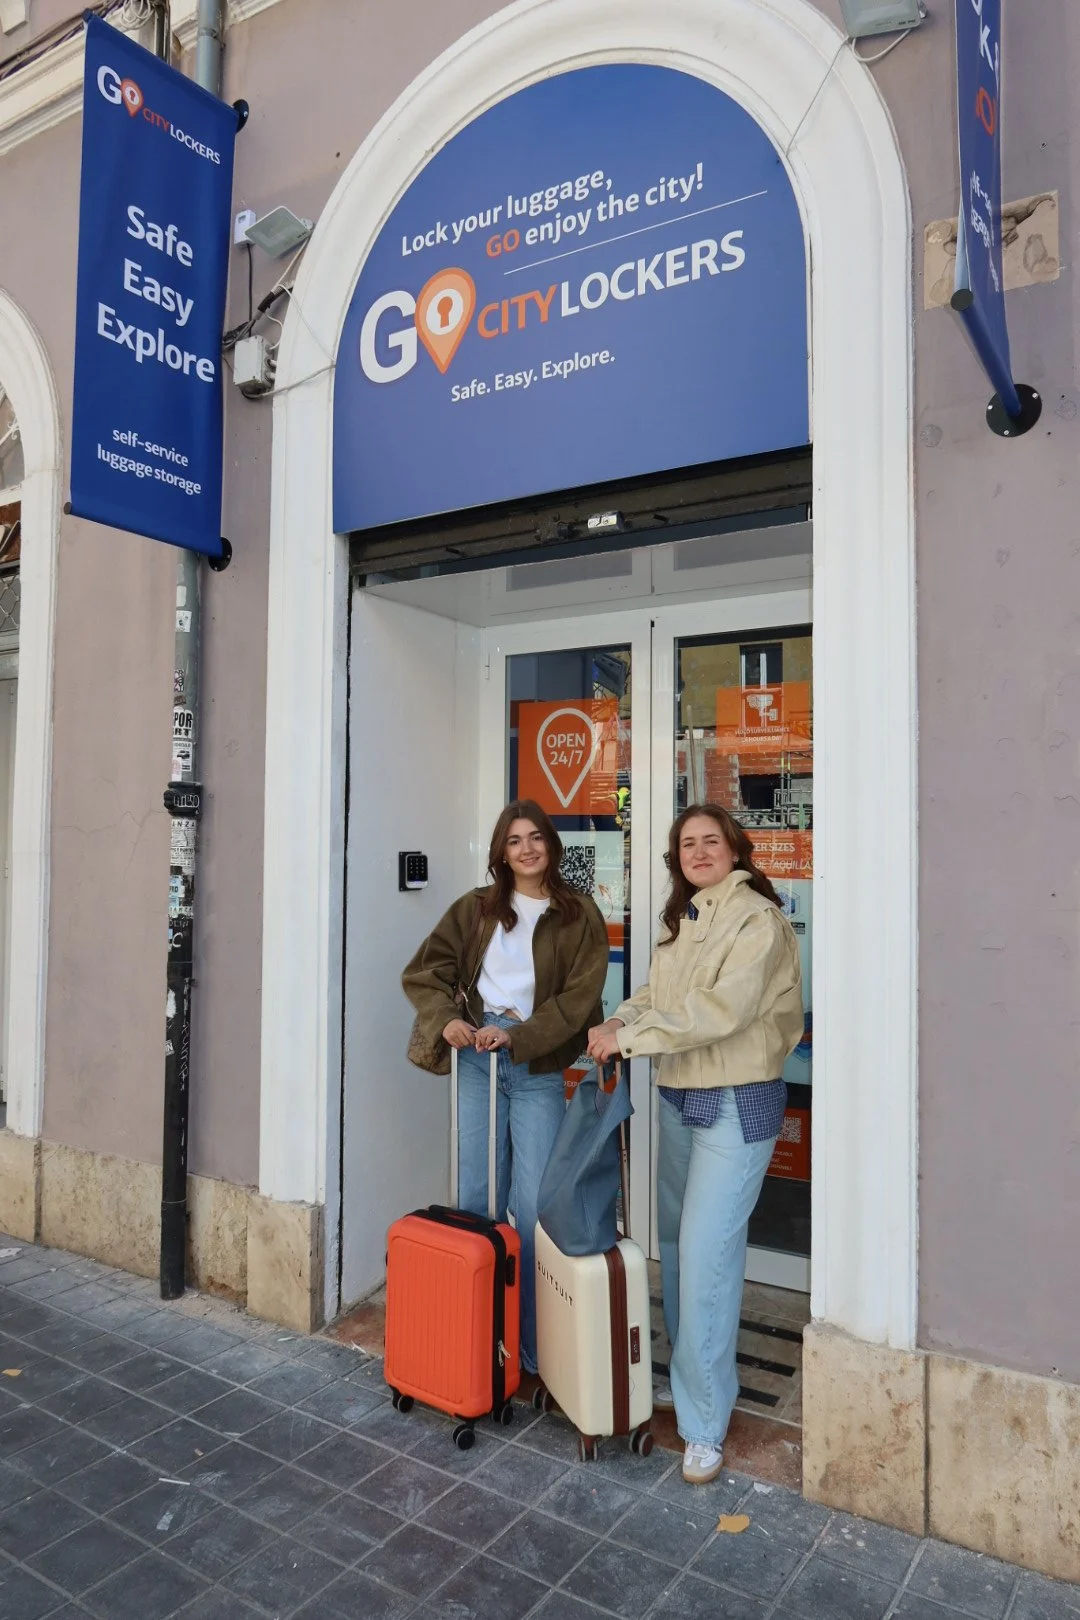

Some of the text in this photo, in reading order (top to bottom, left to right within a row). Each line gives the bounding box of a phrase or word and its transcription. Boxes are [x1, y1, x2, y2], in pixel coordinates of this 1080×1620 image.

[127, 205, 194, 268] Safe
[401, 169, 613, 256] Lock your luggage,
[486, 163, 704, 258] GO enjoy the city!
[124, 258, 194, 328] Easy
[97, 302, 215, 383] Explore
[451, 348, 616, 402] Safe. Easy. Explore.
[97, 444, 202, 497] luggage storage
[112, 426, 189, 467] self-service
[547, 733, 586, 748] OPEN
[550, 750, 583, 767] 24/7
[769, 842, 796, 852] SIZES
[537, 1260, 573, 1307] SUITSUIT
